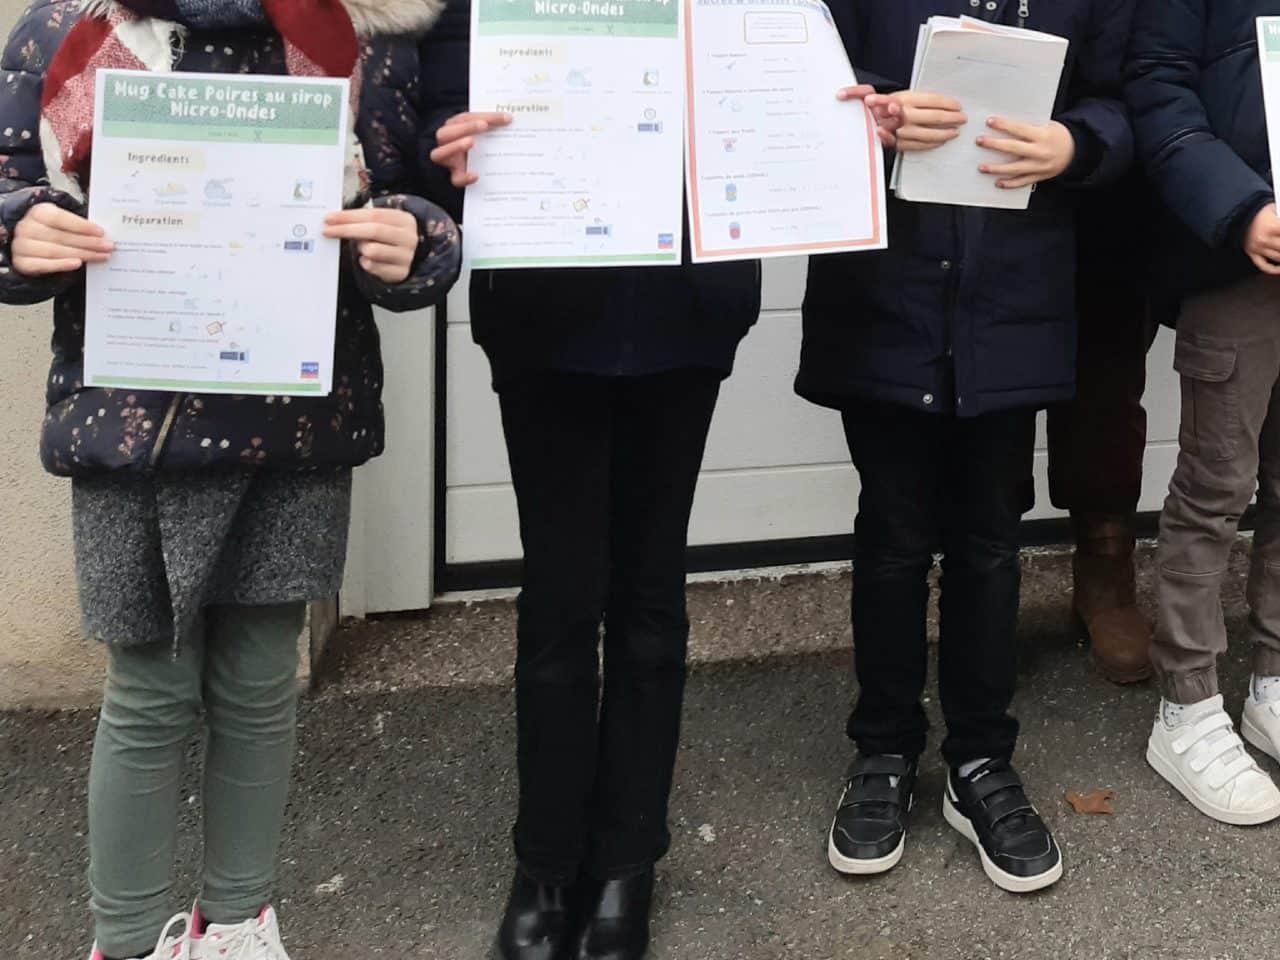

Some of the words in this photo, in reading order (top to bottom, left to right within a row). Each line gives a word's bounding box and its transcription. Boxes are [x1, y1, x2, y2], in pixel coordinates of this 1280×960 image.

[534, 0, 625, 16] Micro-Ondes
[113, 80, 149, 100] Mug
[156, 82, 199, 100] Cake
[205, 85, 259, 102] Poires
[264, 91, 286, 103] au
[290, 88, 333, 109] sirop
[169, 101, 278, 121] Micro-Ondes
[121, 214, 184, 227] Préparation
